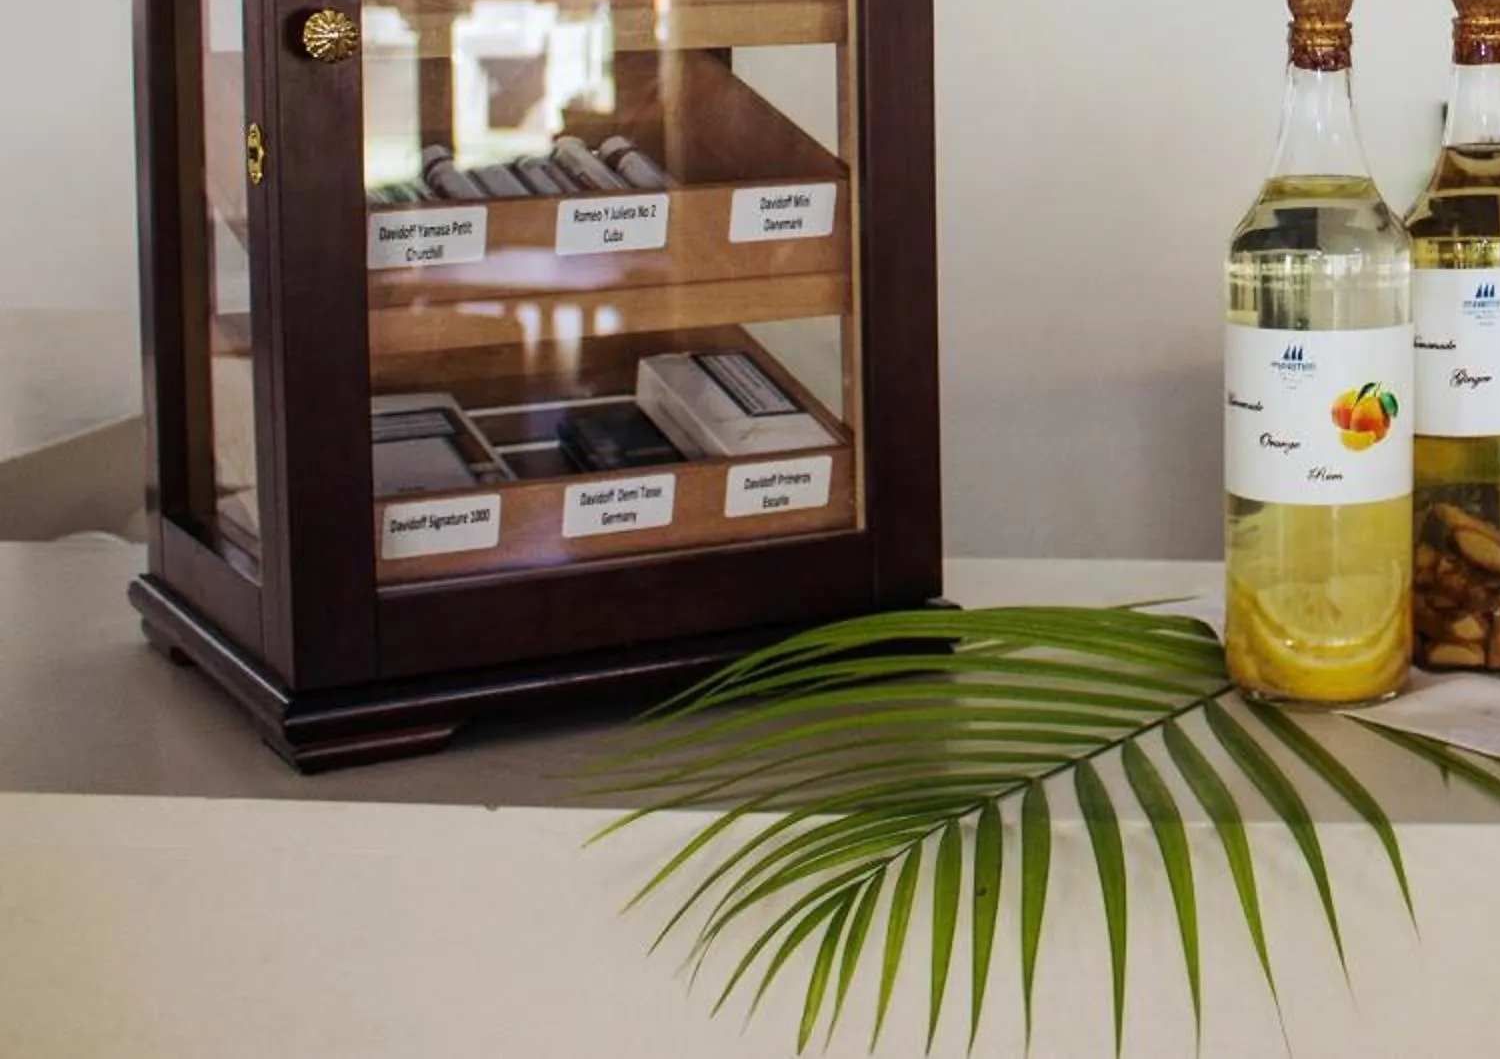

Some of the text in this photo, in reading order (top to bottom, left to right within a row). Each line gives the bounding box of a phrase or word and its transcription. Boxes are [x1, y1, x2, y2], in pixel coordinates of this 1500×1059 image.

[574, 209, 602, 222] Romeo
[638, 204, 649, 217] No
[651, 204, 657, 217] 2
[379, 221, 473, 241] Davidoff Yamasa Petit
[603, 228, 624, 243] Cuba
[1259, 431, 1301, 455] Orange
[1307, 465, 1344, 482] Rum
[390, 515, 427, 533] Davidoff
[428, 512, 469, 530] Signature
